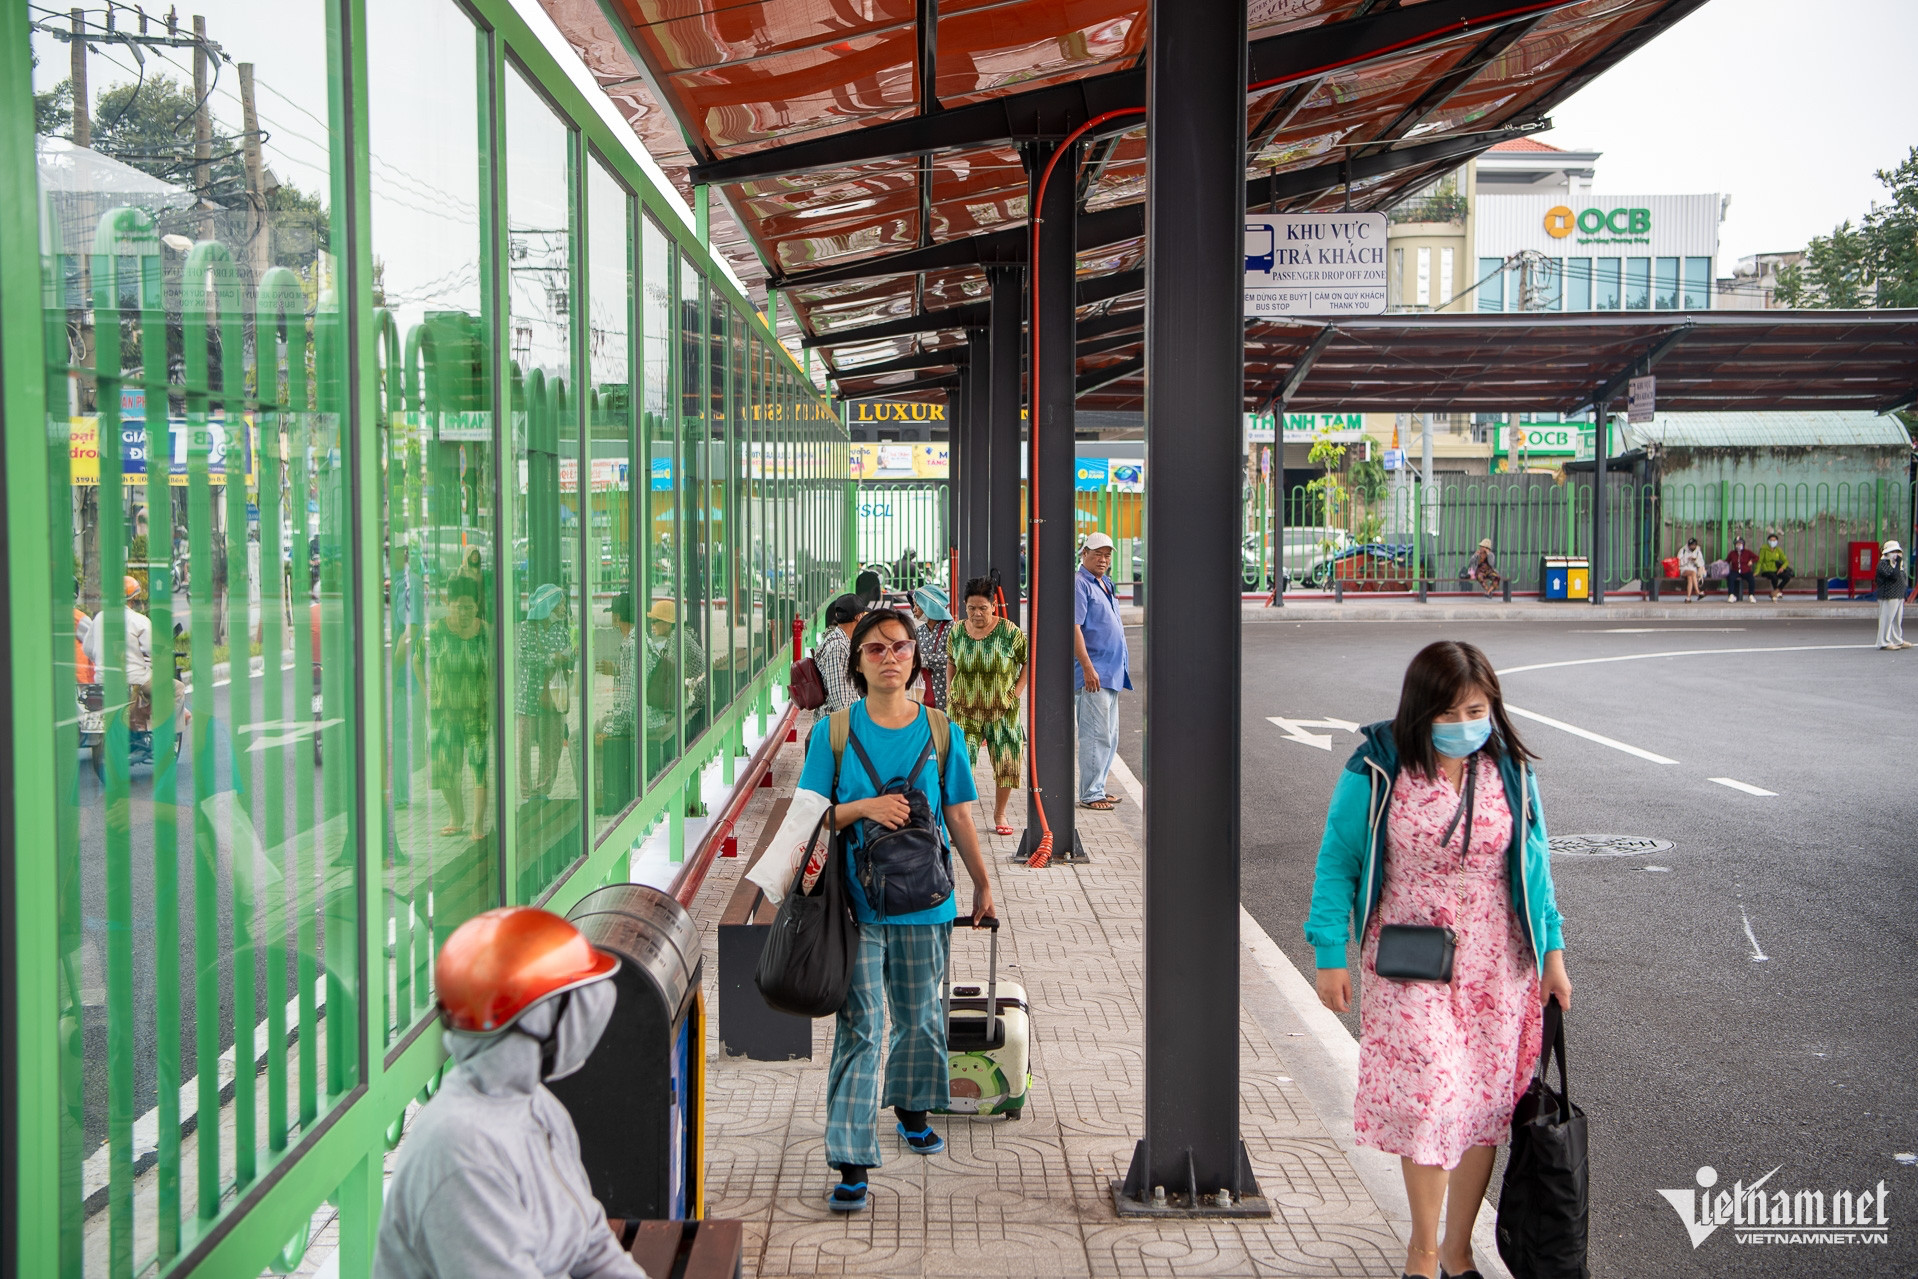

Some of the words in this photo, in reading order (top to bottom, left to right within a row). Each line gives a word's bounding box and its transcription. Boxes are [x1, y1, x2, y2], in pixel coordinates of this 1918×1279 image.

[1577, 208, 1651, 235] OCB
[1287, 224, 1326, 240] KHU
[1330, 220, 1370, 243] VỰC
[1276, 244, 1313, 265] TRẢ
[1318, 242, 1384, 264] KHÁCH
[1272, 271, 1320, 281] PASSENGER
[1322, 271, 1345, 281] DROP
[1345, 270, 1362, 280] OFF
[1363, 270, 1386, 279] ZONE
[1278, 293, 1288, 301] XE
[1289, 292, 1308, 301] BUÝT
[1256, 303, 1271, 311] BUS
[1271, 303, 1290, 311] STOP
[1330, 302, 1353, 310] THANK
[1355, 301, 1370, 309] YOU
[858, 403, 946, 421] LUXUR
[69, 428, 96, 445] oại
[1528, 431, 1568, 445] OCB
[856, 503, 894, 518] SCL
